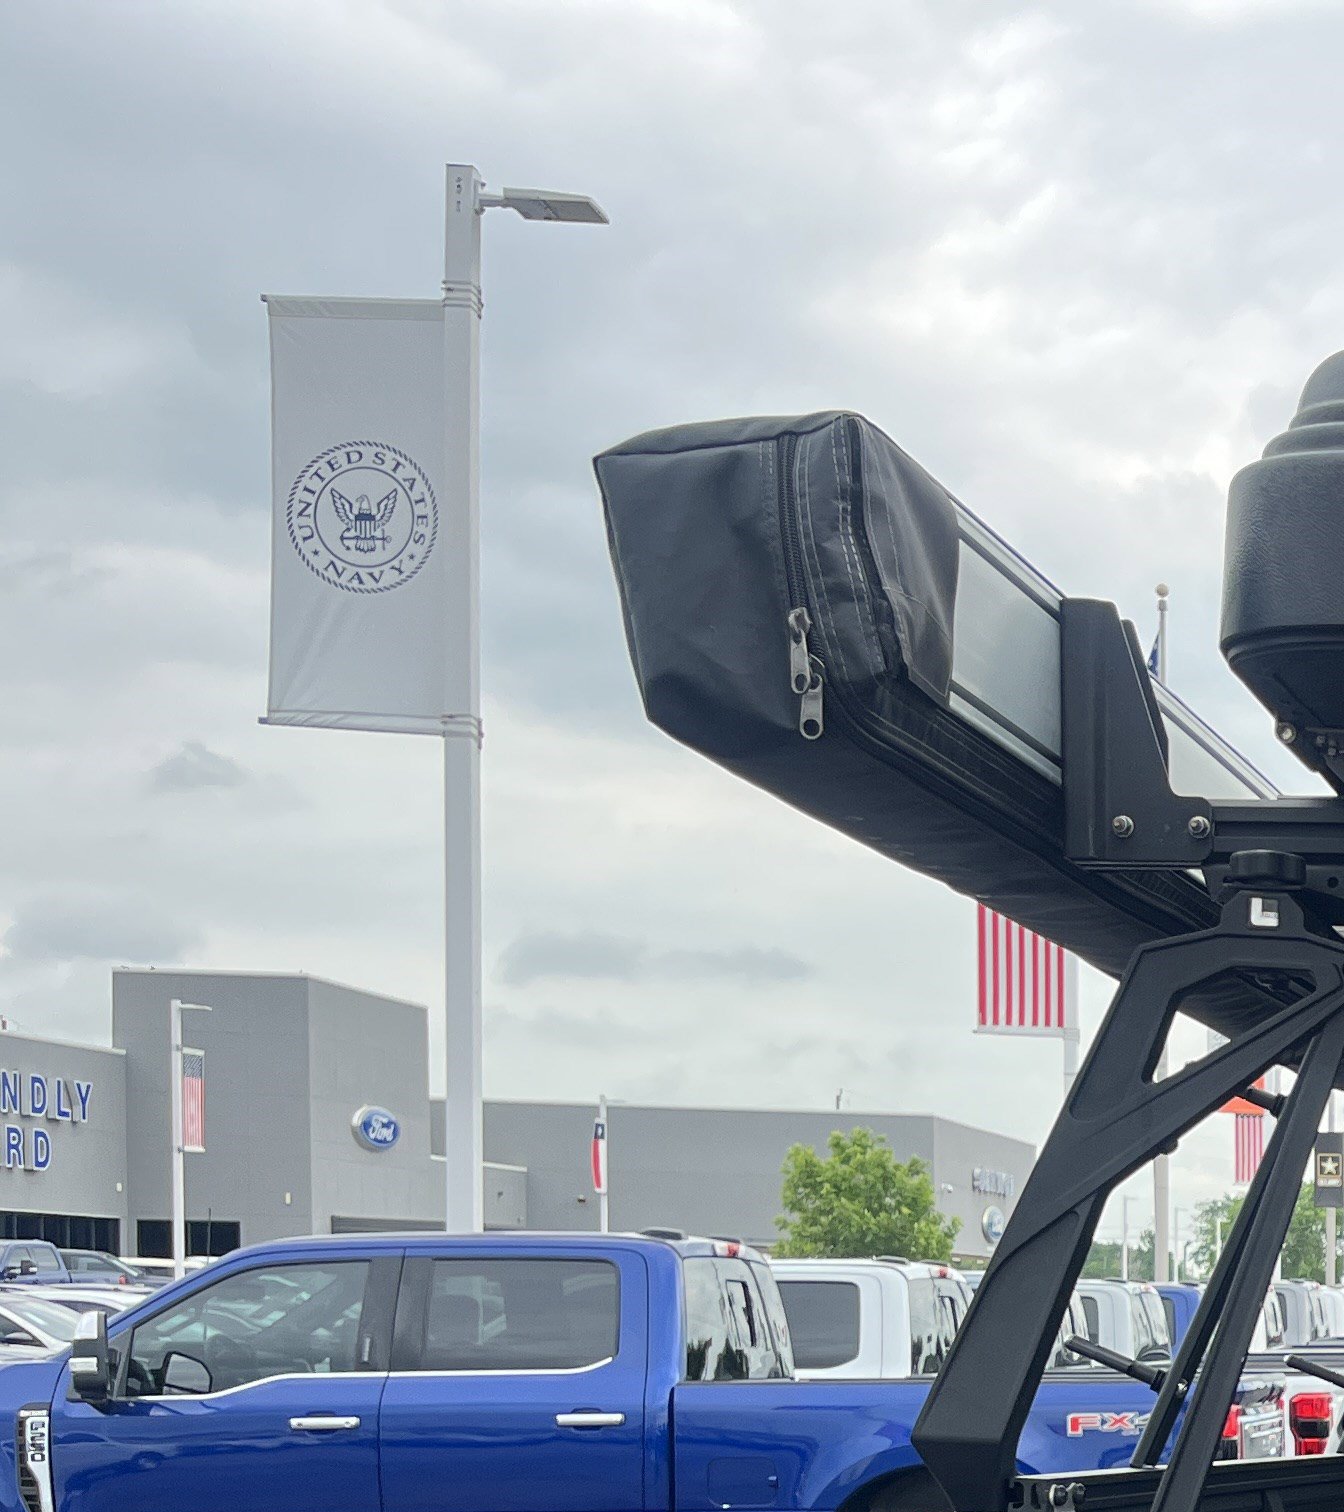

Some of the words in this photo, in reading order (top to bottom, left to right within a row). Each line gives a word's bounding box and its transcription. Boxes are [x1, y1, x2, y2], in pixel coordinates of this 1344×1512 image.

[297, 450, 363, 544] UNITED
[372, 451, 429, 546] STATES
[323, 559, 405, 586] NAVY
